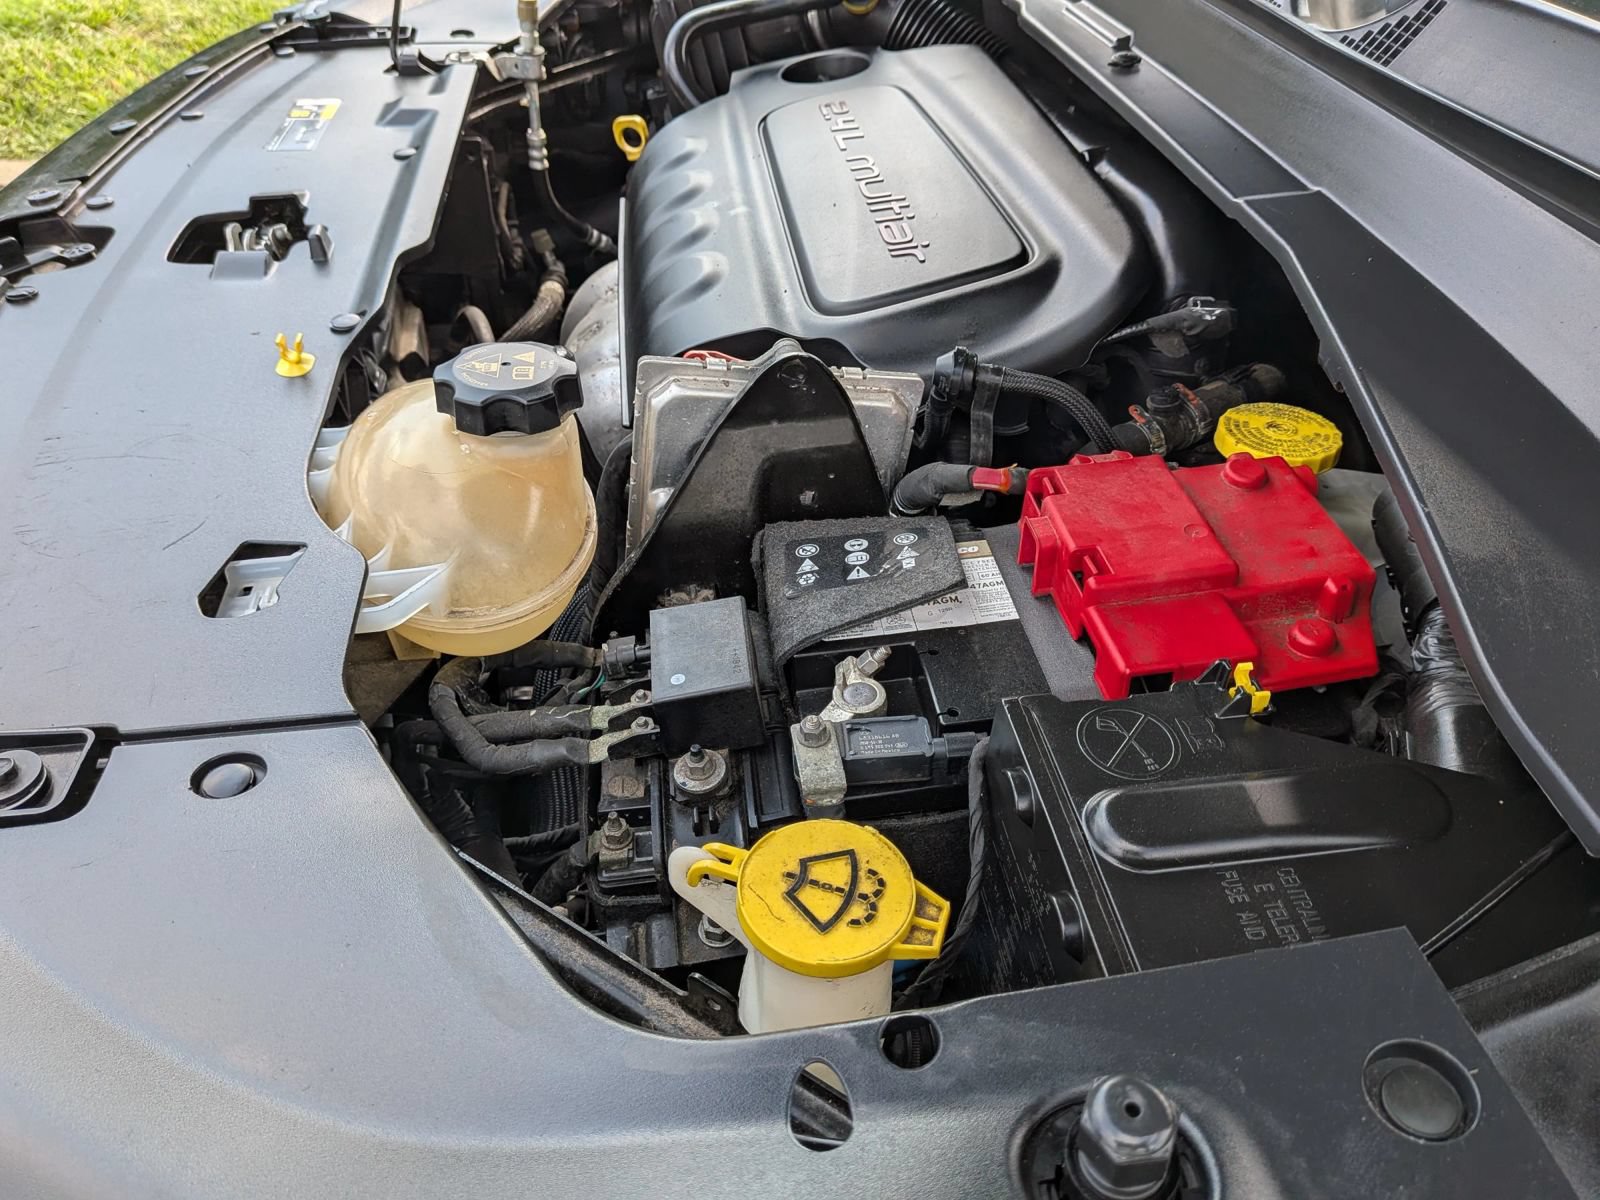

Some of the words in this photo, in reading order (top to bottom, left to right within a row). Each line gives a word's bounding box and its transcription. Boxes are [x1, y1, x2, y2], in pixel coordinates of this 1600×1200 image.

[819, 101, 865, 152] 2.4L
[846, 155, 930, 263] multiair
[969, 579, 1005, 590] 47AGM
[1216, 870, 1250, 905] FUSE
